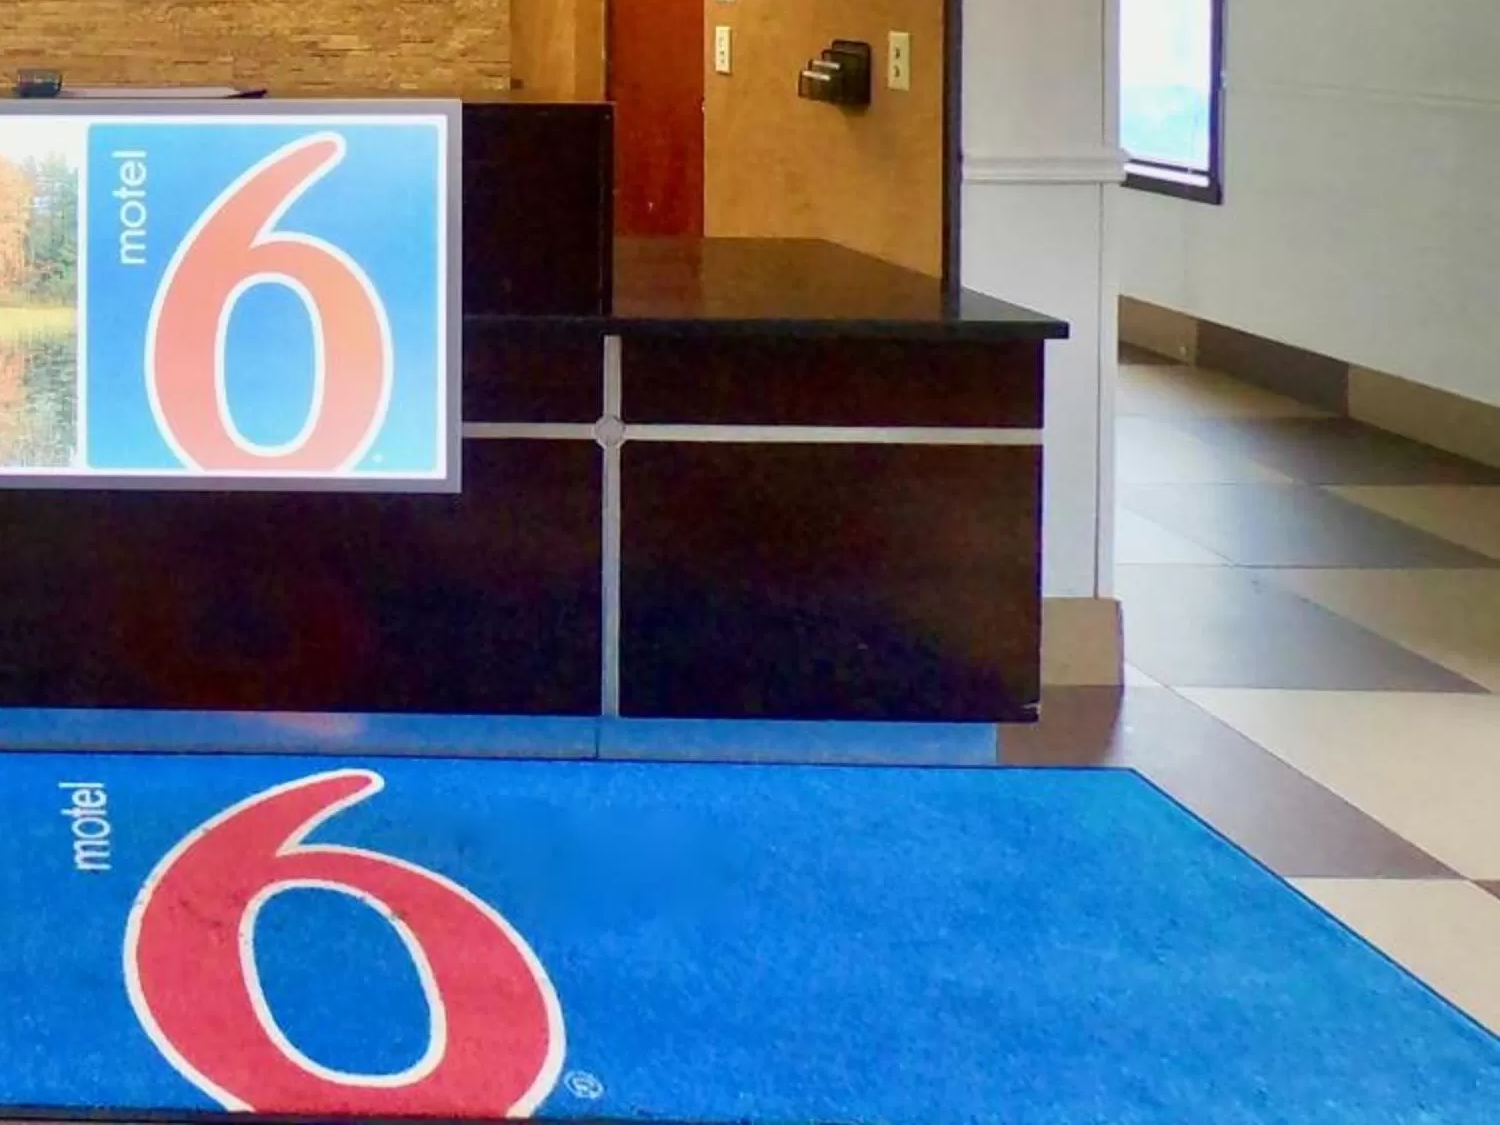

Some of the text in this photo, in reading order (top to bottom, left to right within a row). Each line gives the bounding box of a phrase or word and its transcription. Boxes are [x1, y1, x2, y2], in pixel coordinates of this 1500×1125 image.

[111, 130, 394, 474] motel 6
[58, 768, 567, 1119] motel 6
